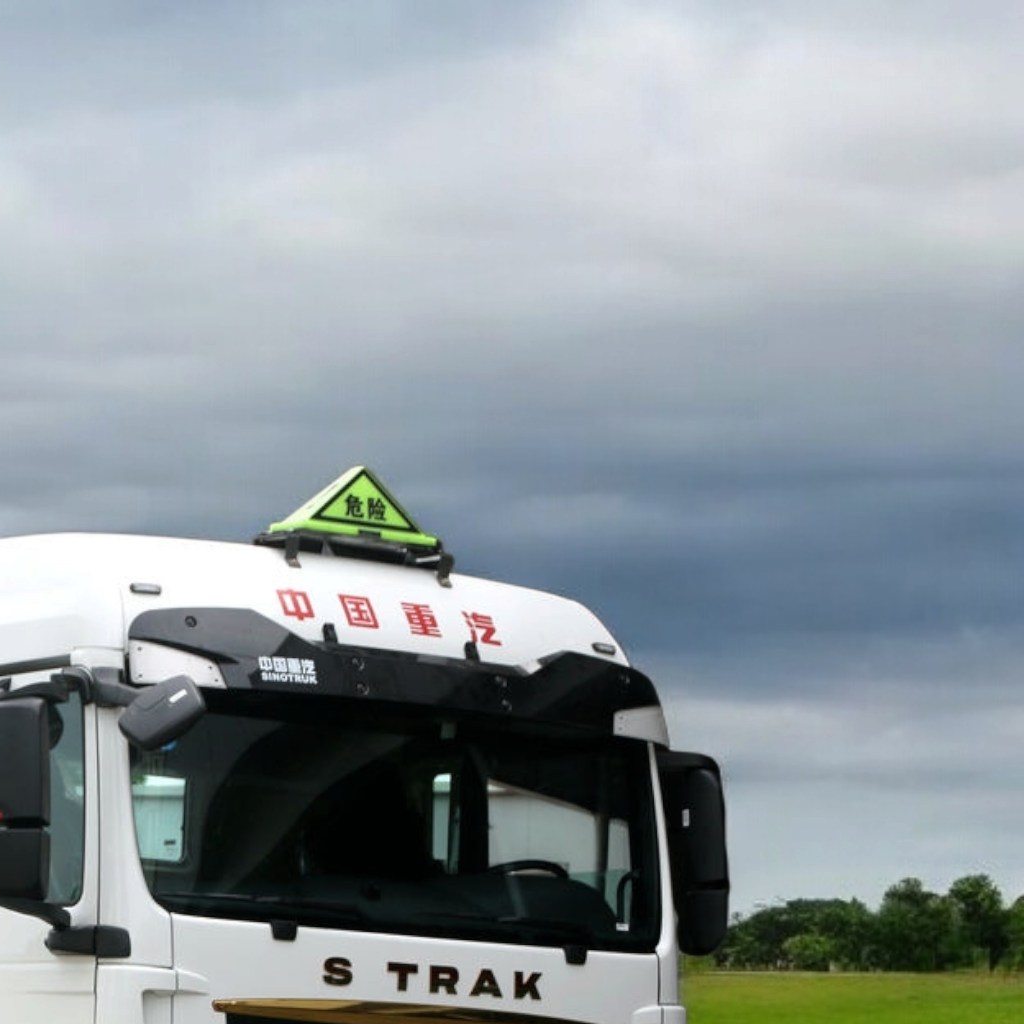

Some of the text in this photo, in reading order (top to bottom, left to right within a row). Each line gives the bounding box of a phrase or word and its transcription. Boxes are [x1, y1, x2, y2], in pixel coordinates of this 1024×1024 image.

[345, 494, 386, 521] 危险
[260, 671, 318, 685] SINOTRUK
[322, 956, 543, 1001] S TRAK
